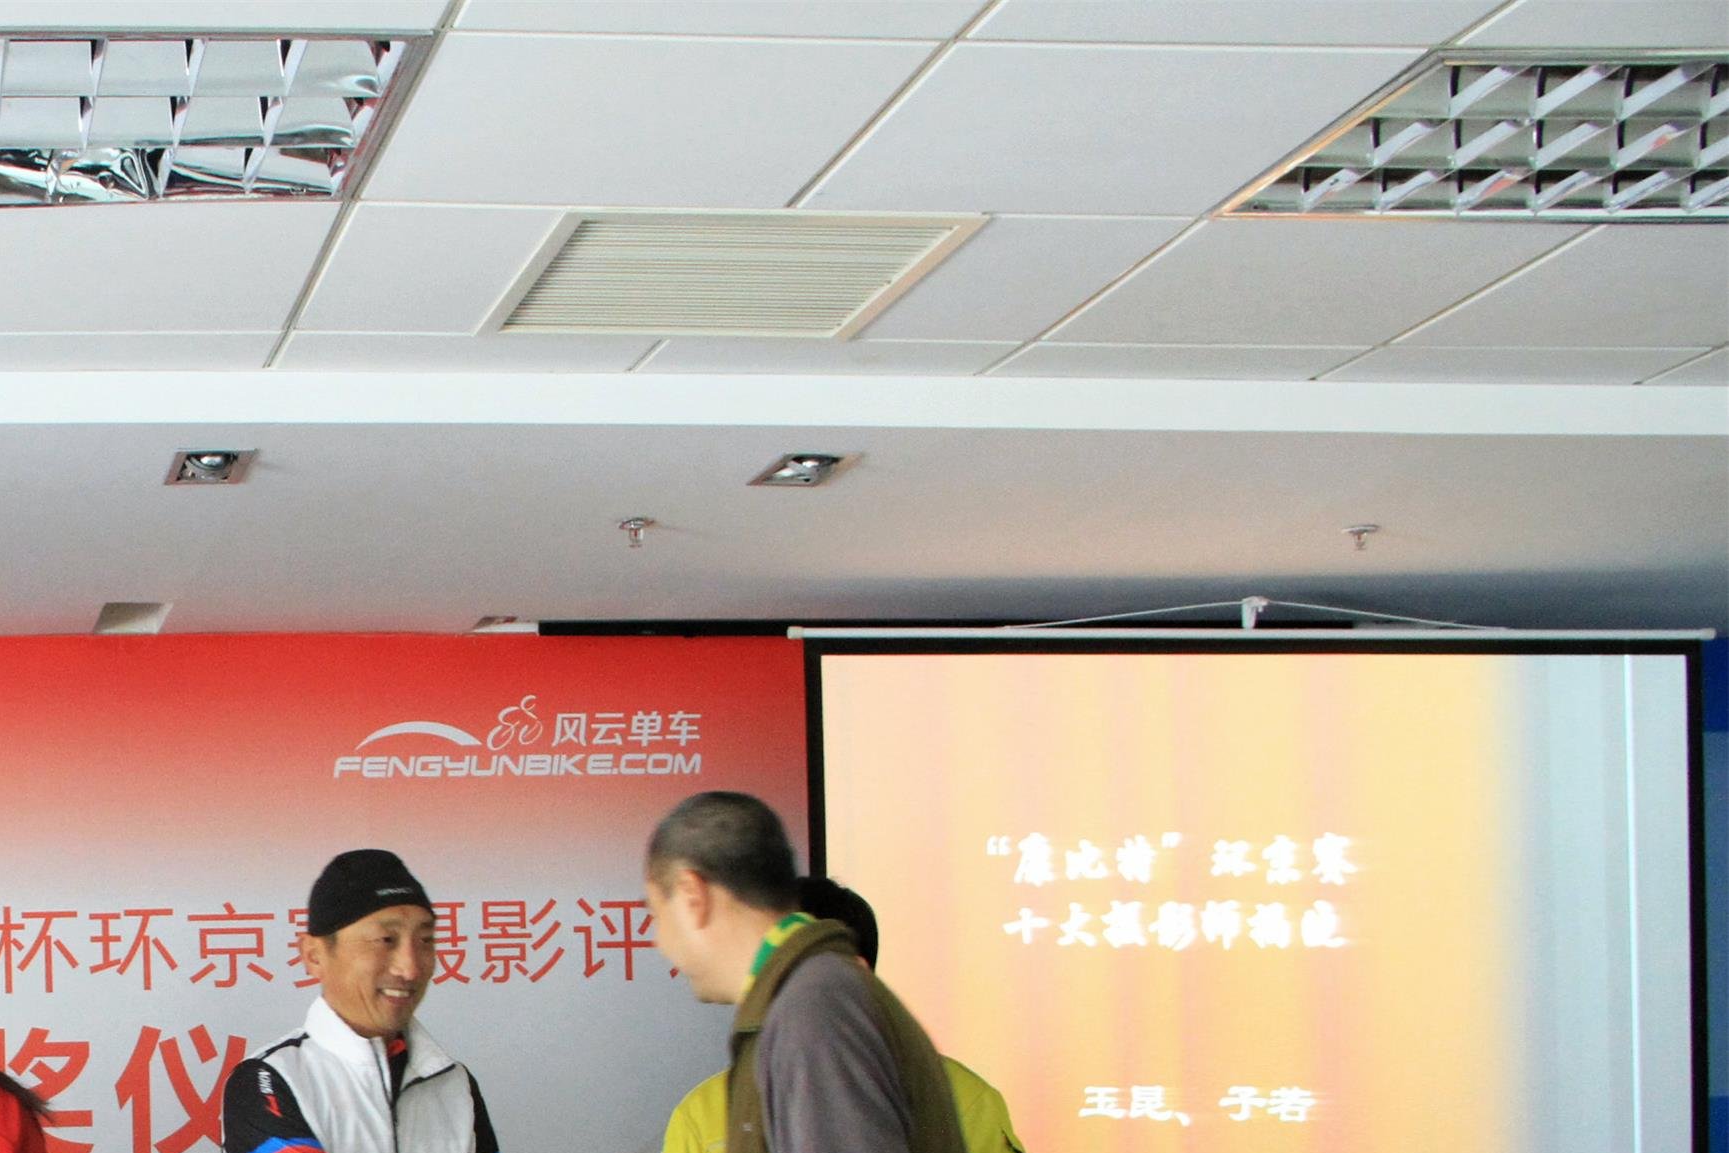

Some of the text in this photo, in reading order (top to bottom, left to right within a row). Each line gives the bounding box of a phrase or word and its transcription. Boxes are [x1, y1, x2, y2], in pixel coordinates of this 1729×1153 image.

[551, 710, 701, 747] 风云单车
[333, 752, 702, 779] FENGYUNBIKE.COM
